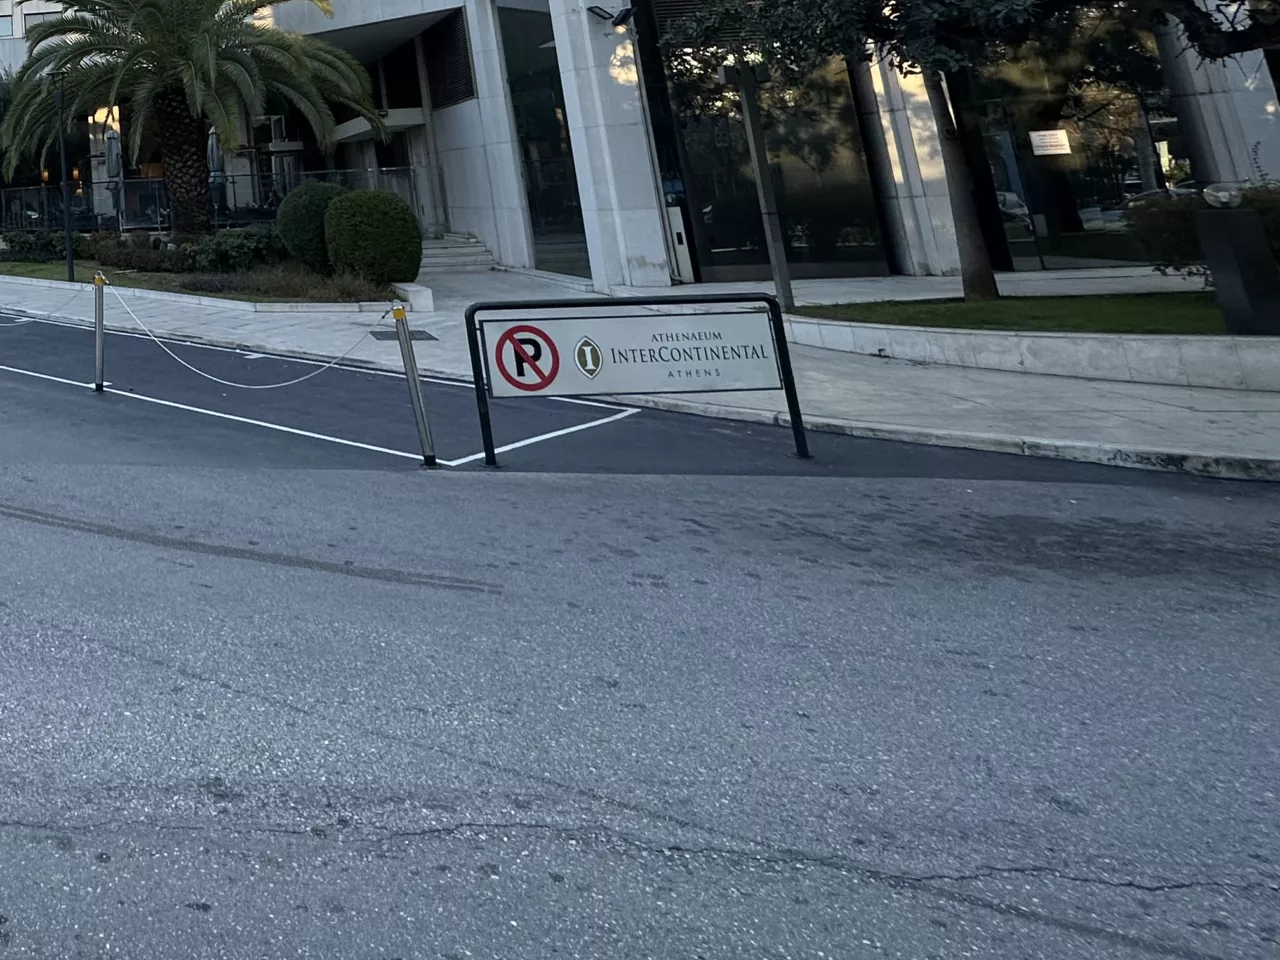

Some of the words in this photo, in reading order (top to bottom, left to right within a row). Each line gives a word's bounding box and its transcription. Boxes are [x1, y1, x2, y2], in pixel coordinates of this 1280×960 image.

[651, 331, 723, 343] ATHENAEUM
[611, 344, 768, 363] INTERCONTINENTAL
[667, 368, 721, 379] ATHENS
